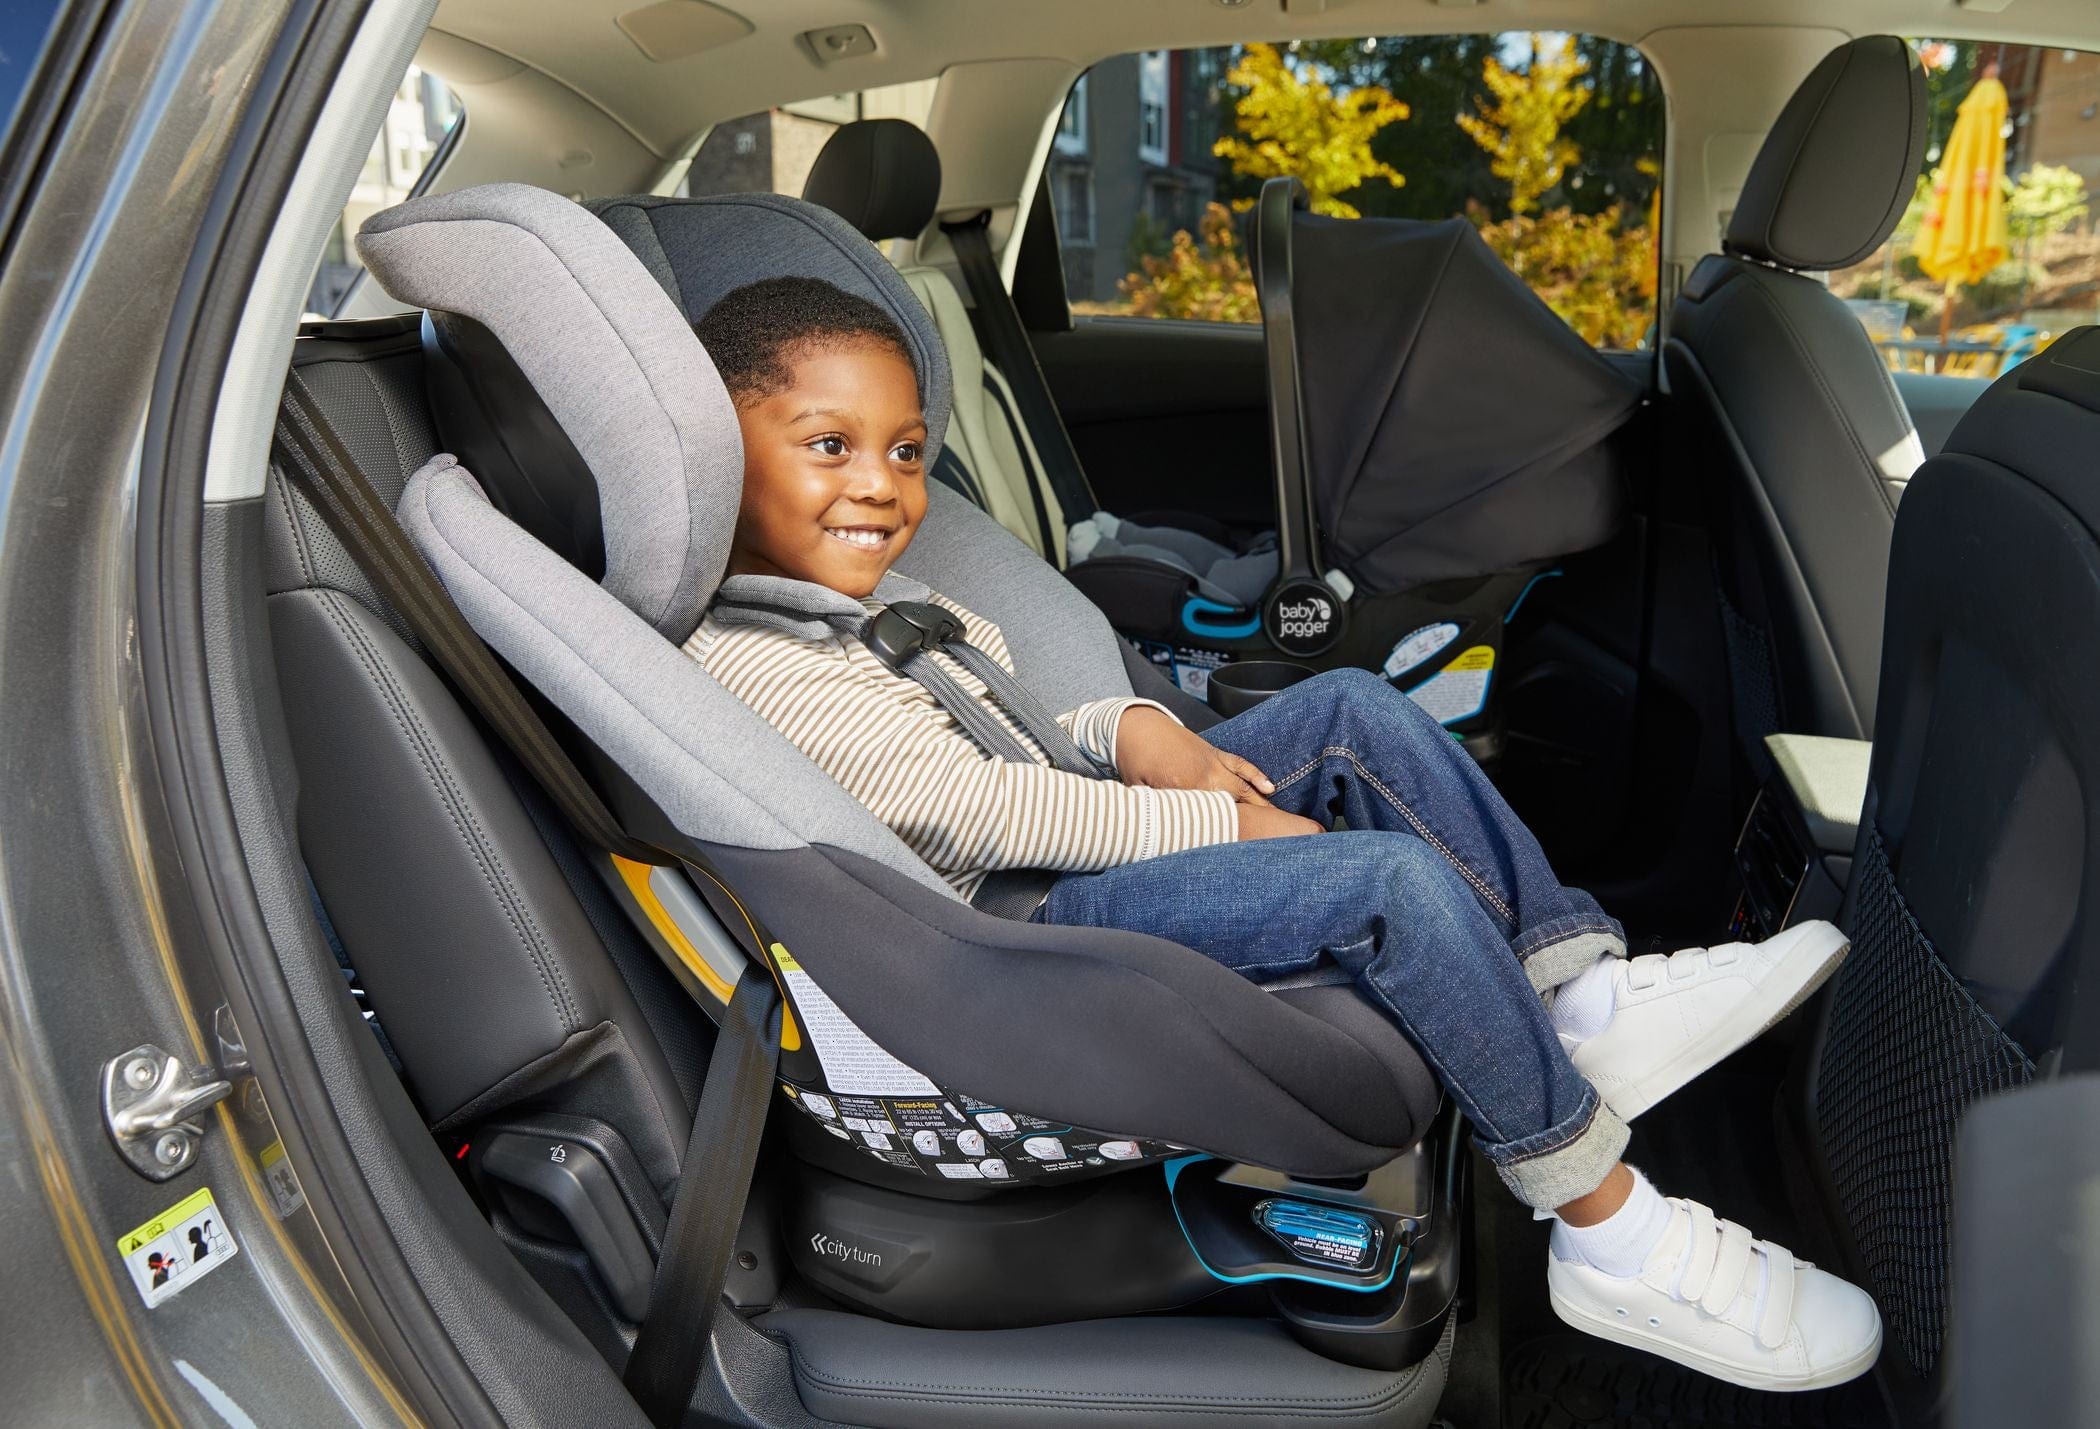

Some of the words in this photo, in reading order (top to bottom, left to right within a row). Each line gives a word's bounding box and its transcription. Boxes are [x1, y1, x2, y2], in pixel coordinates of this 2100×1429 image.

[1279, 601, 1316, 622] baby
[1279, 619, 1330, 638] jogger
[893, 1102, 938, 1110] Forward-Facing
[1297, 1236, 1317, 1245] Vehicle
[1316, 1232, 1363, 1247] REAR-FACING
[827, 1240, 852, 1262] city
[853, 1246, 882, 1266] turn
